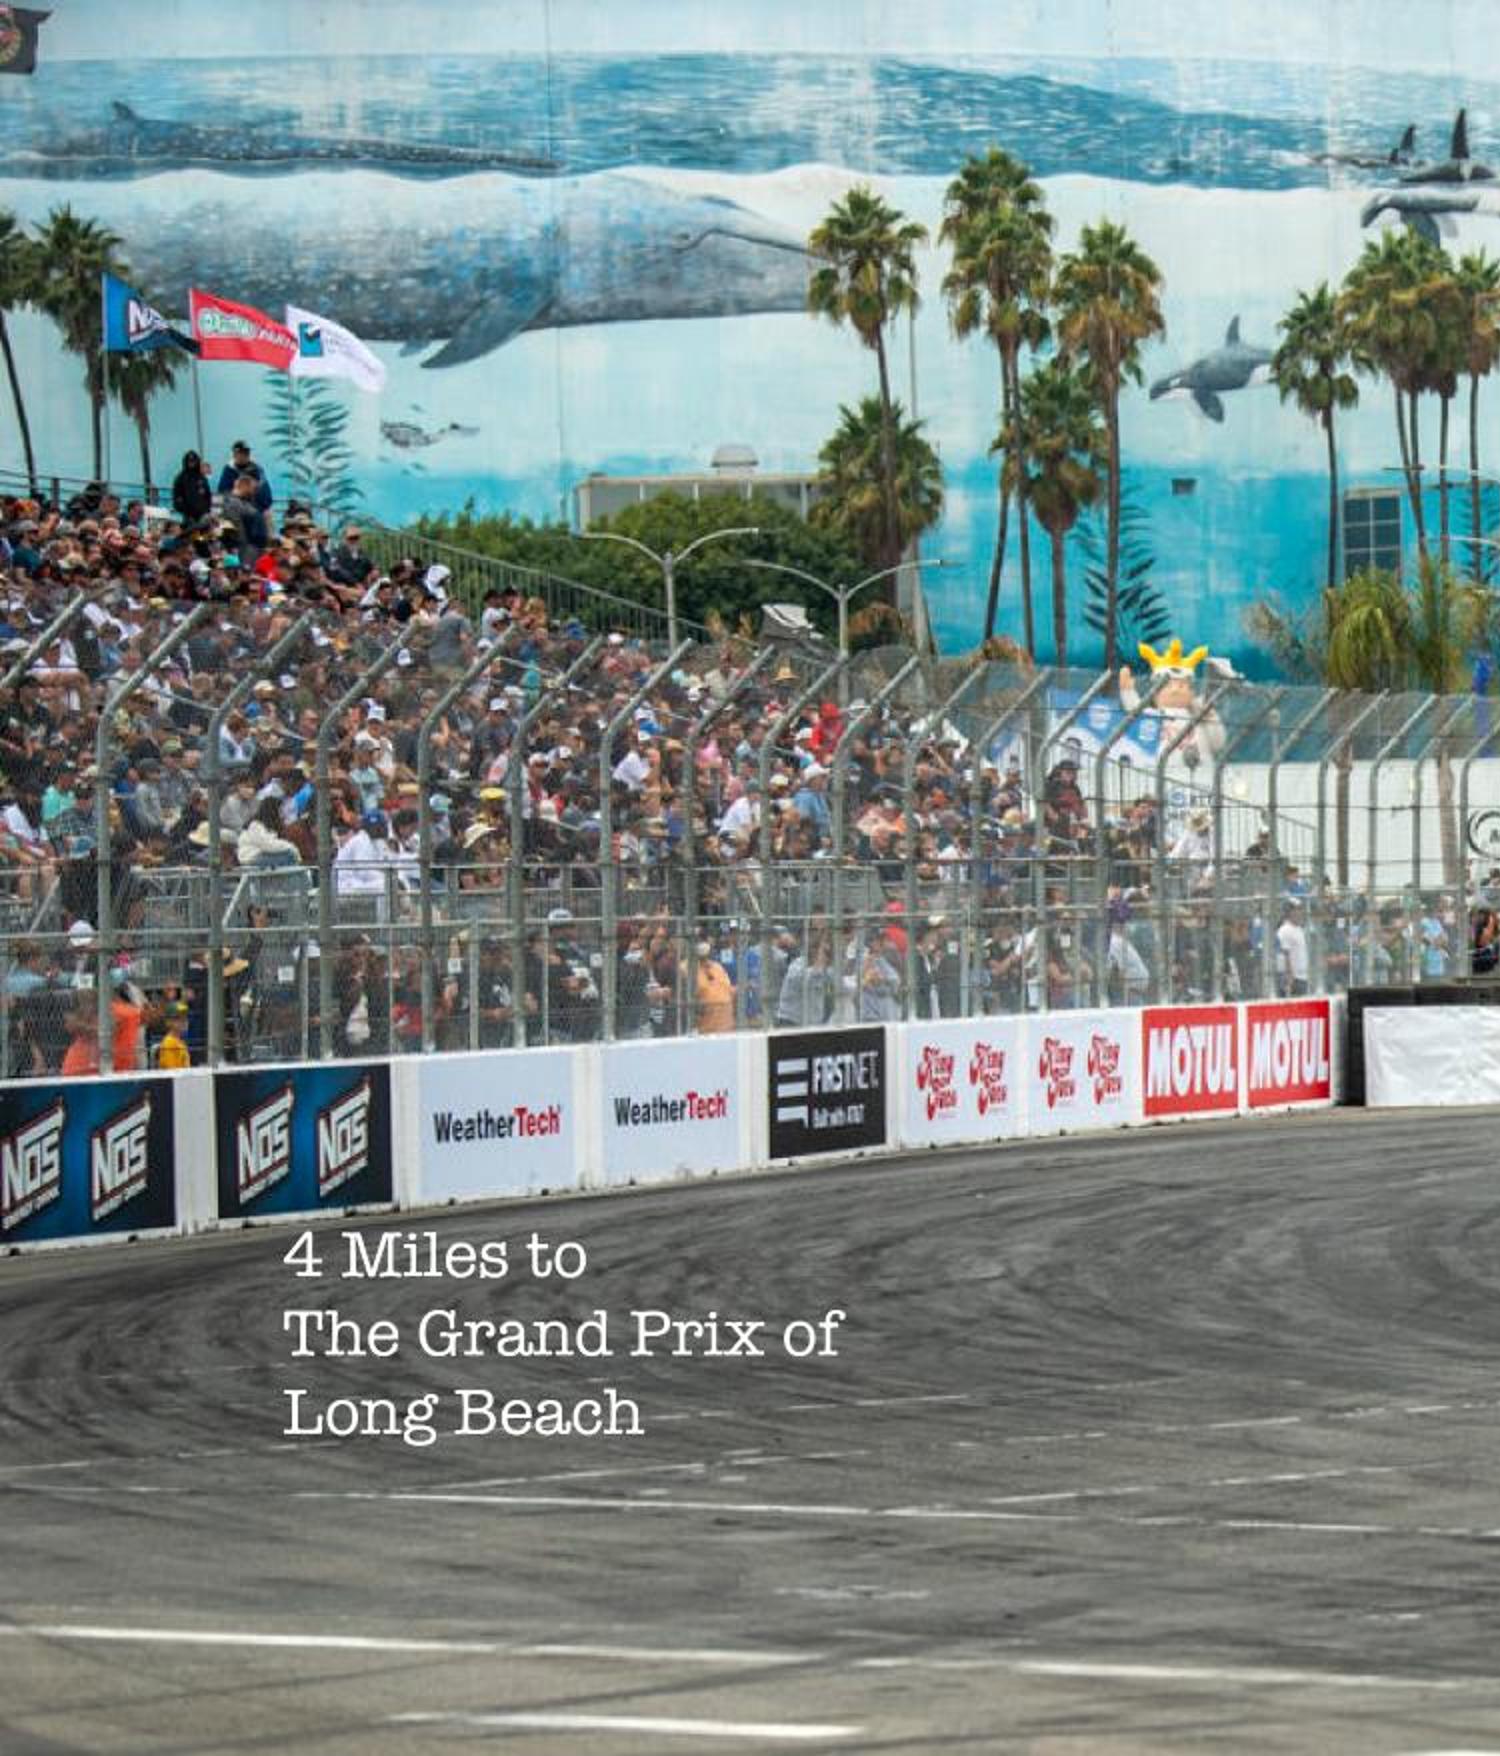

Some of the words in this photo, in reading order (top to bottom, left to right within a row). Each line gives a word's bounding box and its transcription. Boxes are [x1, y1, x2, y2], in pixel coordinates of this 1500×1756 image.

[1147, 1024, 1237, 1099] MOTUL
[1250, 1018, 1329, 1090] MOTUL
[92, 1098, 150, 1209] NOS
[238, 1081, 294, 1192] NOS
[319, 1076, 371, 1184] NOS
[434, 1106, 560, 1144] WeatherTech
[614, 1091, 727, 1126] WeatherTech
[2, 1099, 64, 1215] NOS
